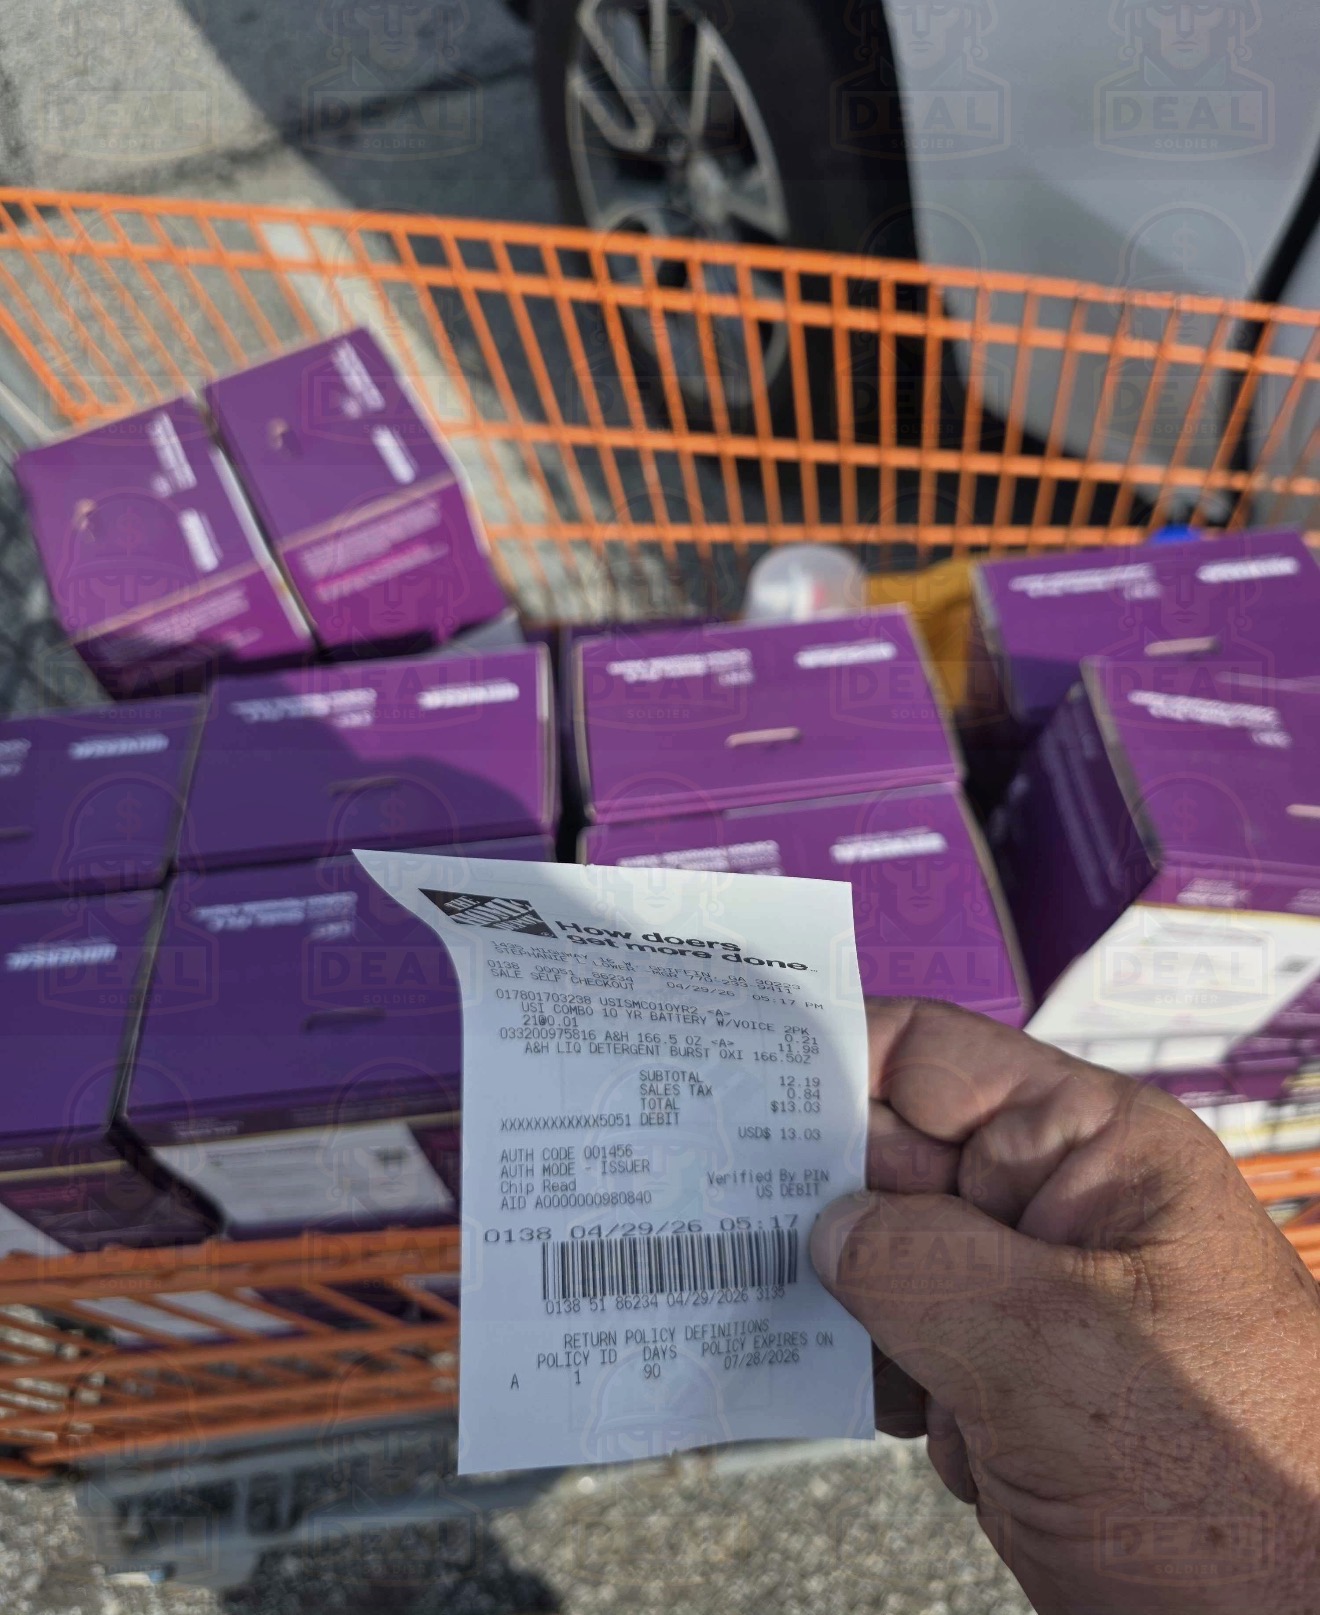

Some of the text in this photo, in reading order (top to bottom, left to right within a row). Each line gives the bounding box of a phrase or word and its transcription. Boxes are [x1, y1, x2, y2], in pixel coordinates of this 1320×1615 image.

[555, 920, 741, 951] How doers
[566, 934, 619, 949] get
[626, 941, 712, 959] more
[494, 946, 568, 962] STEPHANIE
[592, 960, 636, 972] LOWER
[487, 959, 823, 1009] 0138 00051 86234 04/29/26 05:17 PM
[491, 968, 634, 990] SALE SELF CHECKOUT
[496, 988, 592, 1005] 017801703238
[521, 1001, 809, 1035] USI COMBO 10 YR BATTERY W/VOICE 2PK
[522, 1014, 817, 1045] 21@0.01 0.21
[500, 1026, 597, 1041] 033200975816
[605, 1030, 629, 1042] A&H
[638, 1032, 677, 1045] 166.5
[778, 1043, 819, 1054] 11.98
[525, 1041, 550, 1054] A&H
[557, 1042, 582, 1054] LIQ
[589, 1042, 661, 1056] DETERGENT
[670, 1045, 710, 1058] BURST
[639, 1069, 821, 1087] SUBTOTAL 12.19
[639, 1083, 821, 1100] SALES TAX 0.84
[641, 1098, 821, 1113] TOTAL $13.03
[640, 1112, 681, 1126] DEBIT
[738, 1126, 821, 1140] USD$ 13.03
[500, 1144, 633, 1164] AUTH CODE 001456
[500, 1164, 535, 1179] AUTH
[542, 1162, 576, 1176] MODE
[601, 1159, 650, 1175] ISSUER
[500, 1168, 830, 1195] Chip Read Verified By PIN
[501, 1195, 527, 1210] AID
[755, 1184, 773, 1199] US
[780, 1183, 820, 1197] DEBIT
[484, 1227, 552, 1243] 0138
[570, 1219, 702, 1240] 04/29/26
[720, 1213, 798, 1232] 05:17
[545, 1300, 581, 1315] 0138
[590, 1296, 607, 1312] 51
[615, 1294, 659, 1310] 86234
[666, 1287, 749, 1307] 04/29/2026
[564, 1319, 770, 1349] RETURN POLICY DEFINITIONS
[537, 1331, 834, 1368] POLICY ID DAYS POLICY EXPIRES ON
[510, 1348, 800, 1390] A 1 90 07/28/2026
